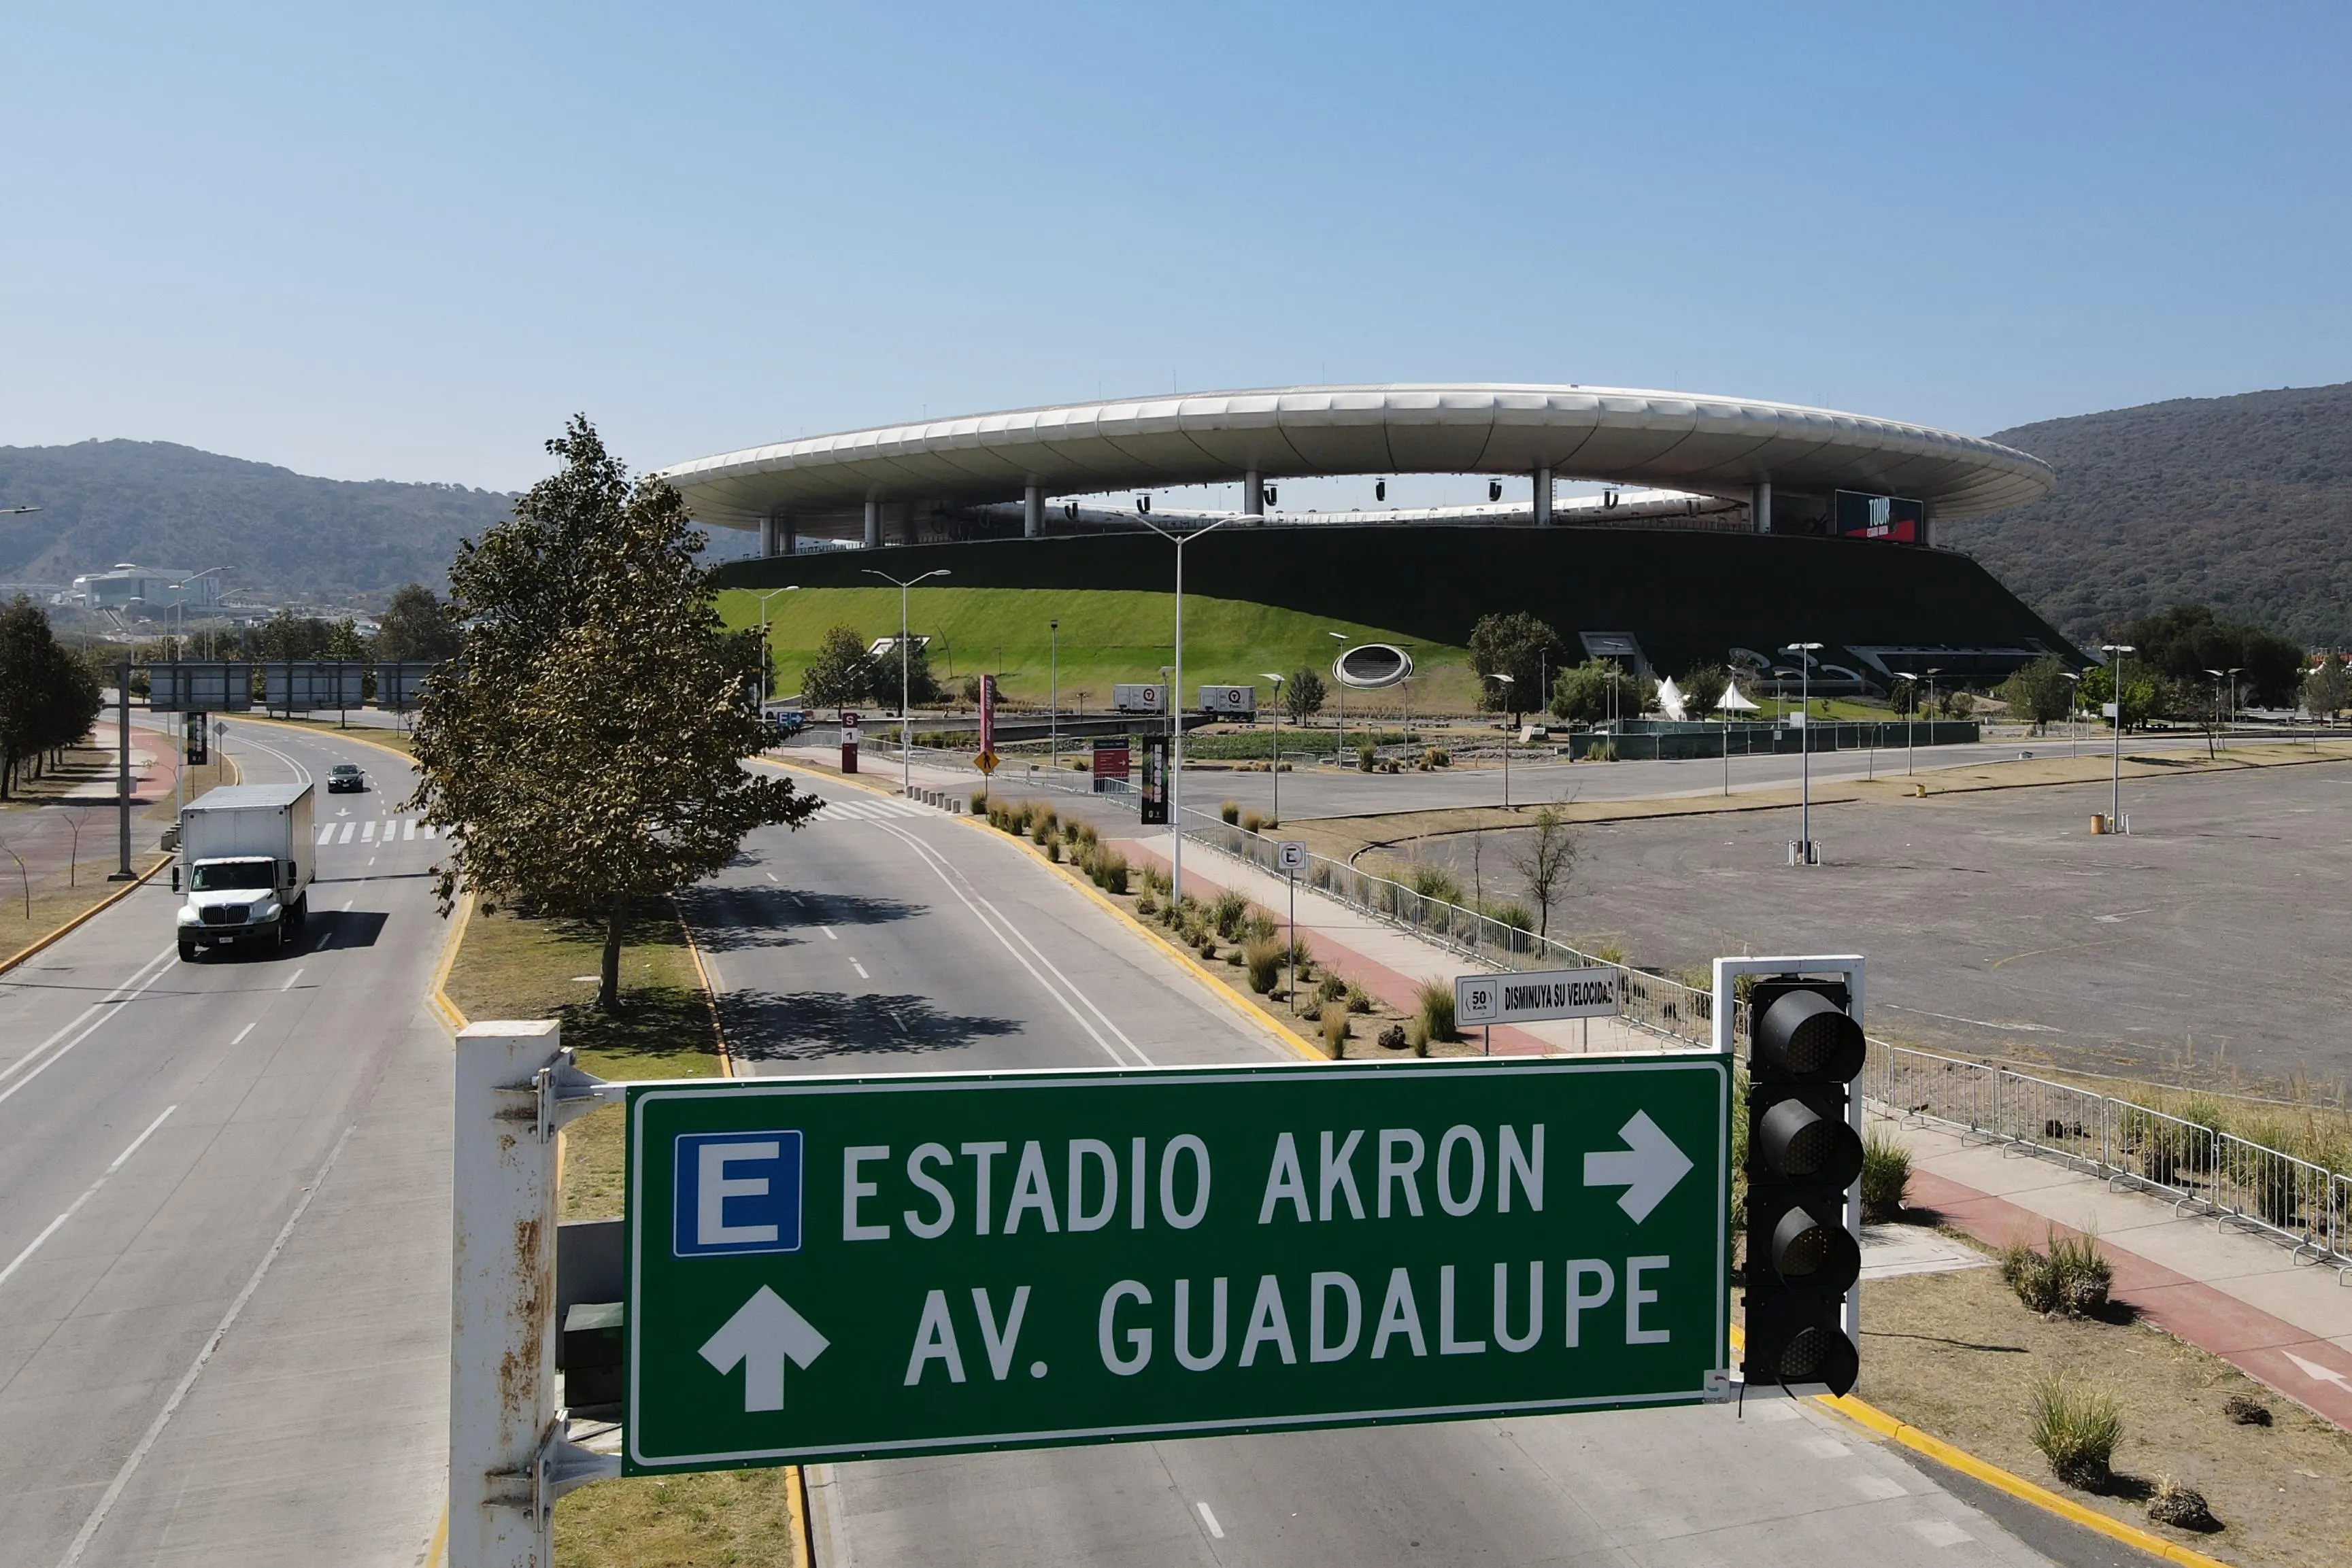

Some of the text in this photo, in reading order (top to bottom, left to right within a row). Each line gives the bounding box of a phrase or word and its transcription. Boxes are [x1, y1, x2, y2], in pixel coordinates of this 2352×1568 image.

[1868, 497, 1889, 527] TOUR
[779, 713, 788, 724] E
[846, 716, 854, 726] S
[845, 732, 853, 740] 1
[1472, 991, 1487, 1005] 50
[1505, 984, 1552, 1010] DISMINUYA
[1553, 983, 1565, 1008] SU
[696, 1141, 780, 1246] E
[843, 1123, 1545, 1242] ESTADIO AKRON
[903, 1255, 1670, 1386] AV. GUADALUPE
